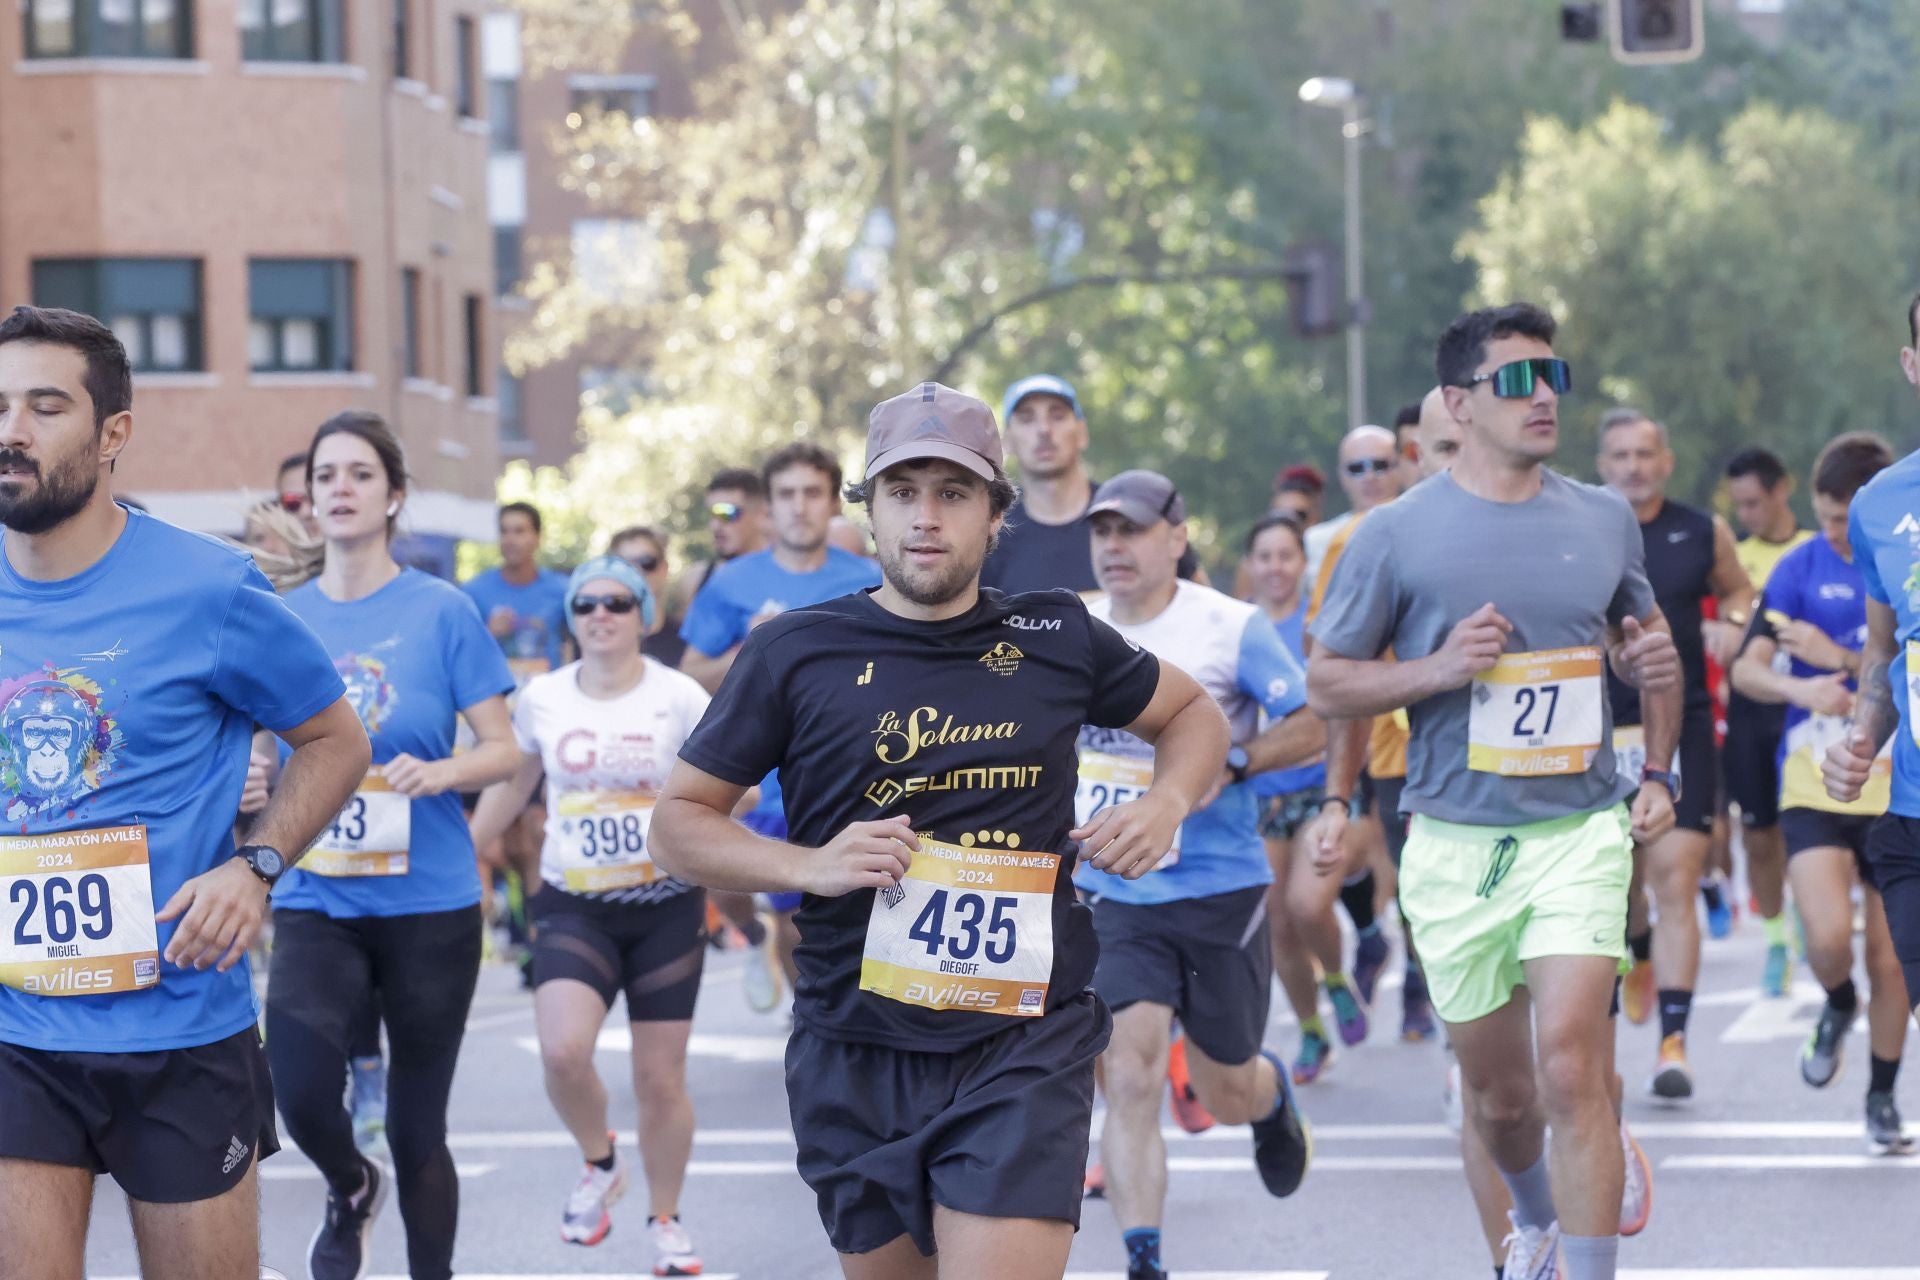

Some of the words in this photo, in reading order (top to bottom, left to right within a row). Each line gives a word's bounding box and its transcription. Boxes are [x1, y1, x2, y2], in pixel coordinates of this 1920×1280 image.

[1513, 685, 1560, 736] 27
[875, 706, 1022, 764] Solana
[905, 766, 1043, 797] SUMMIT
[6, 839, 39, 851] MEDIA
[41, 832, 100, 849] MARATÓN
[102, 828, 142, 843] AVILÉS
[579, 815, 643, 857] 398
[36, 853, 73, 867] 2024
[928, 846, 963, 861] MEDIA
[965, 852, 1019, 867] MARATÓN
[956, 869, 994, 885] 2024
[9, 873, 113, 945] 269
[908, 889, 1018, 964] 435
[47, 944, 82, 958] MIGUEL
[939, 960, 980, 976] DIEGOFF
[222, 1144, 249, 1174] adidas
